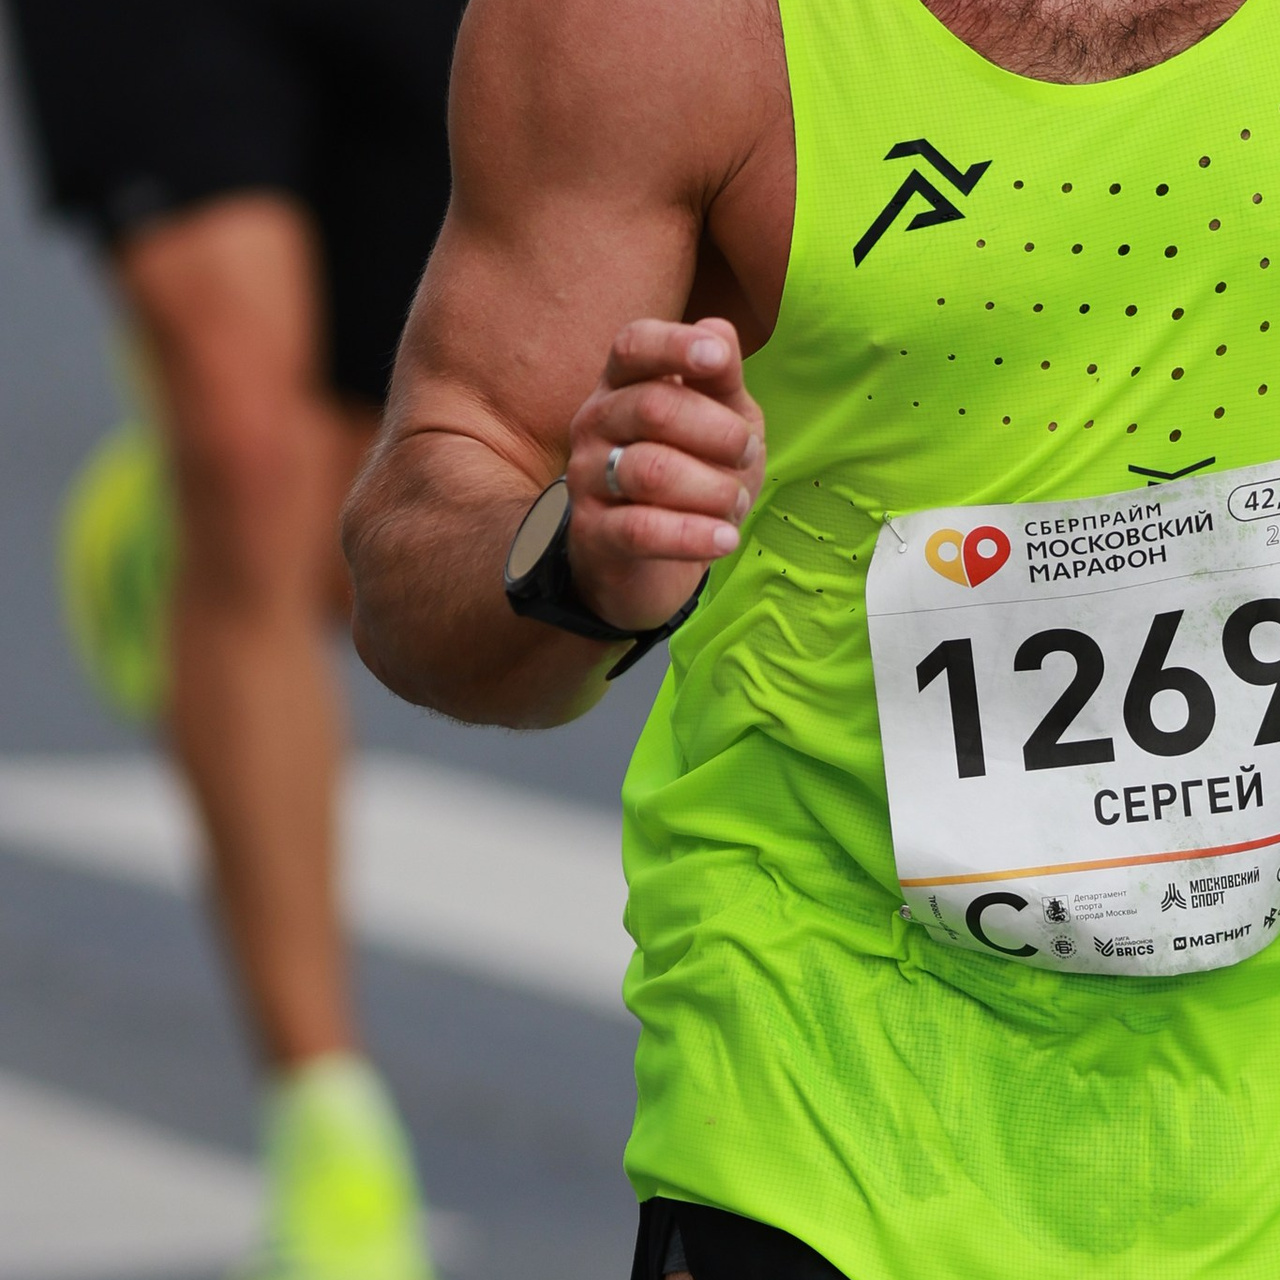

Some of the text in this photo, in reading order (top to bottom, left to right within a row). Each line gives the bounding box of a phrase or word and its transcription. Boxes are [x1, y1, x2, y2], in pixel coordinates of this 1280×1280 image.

[1024, 502, 1162, 537] СБЕРПРАЙМ
[1026, 509, 1214, 561] МОСКОВСКИЙ
[1028, 544, 1167, 584] МАРАФОН
[1093, 763, 1265, 826] СЕРГЕЙ
[1189, 866, 1261, 894] МОСКОВСКИЙ
[1073, 890, 1128, 904] Департамент
[1074, 902, 1103, 912] спорта
[1191, 890, 1226, 910] СПОРТ
[1075, 908, 1138, 921] города Москвы
[1115, 944, 1155, 957] BRICS
